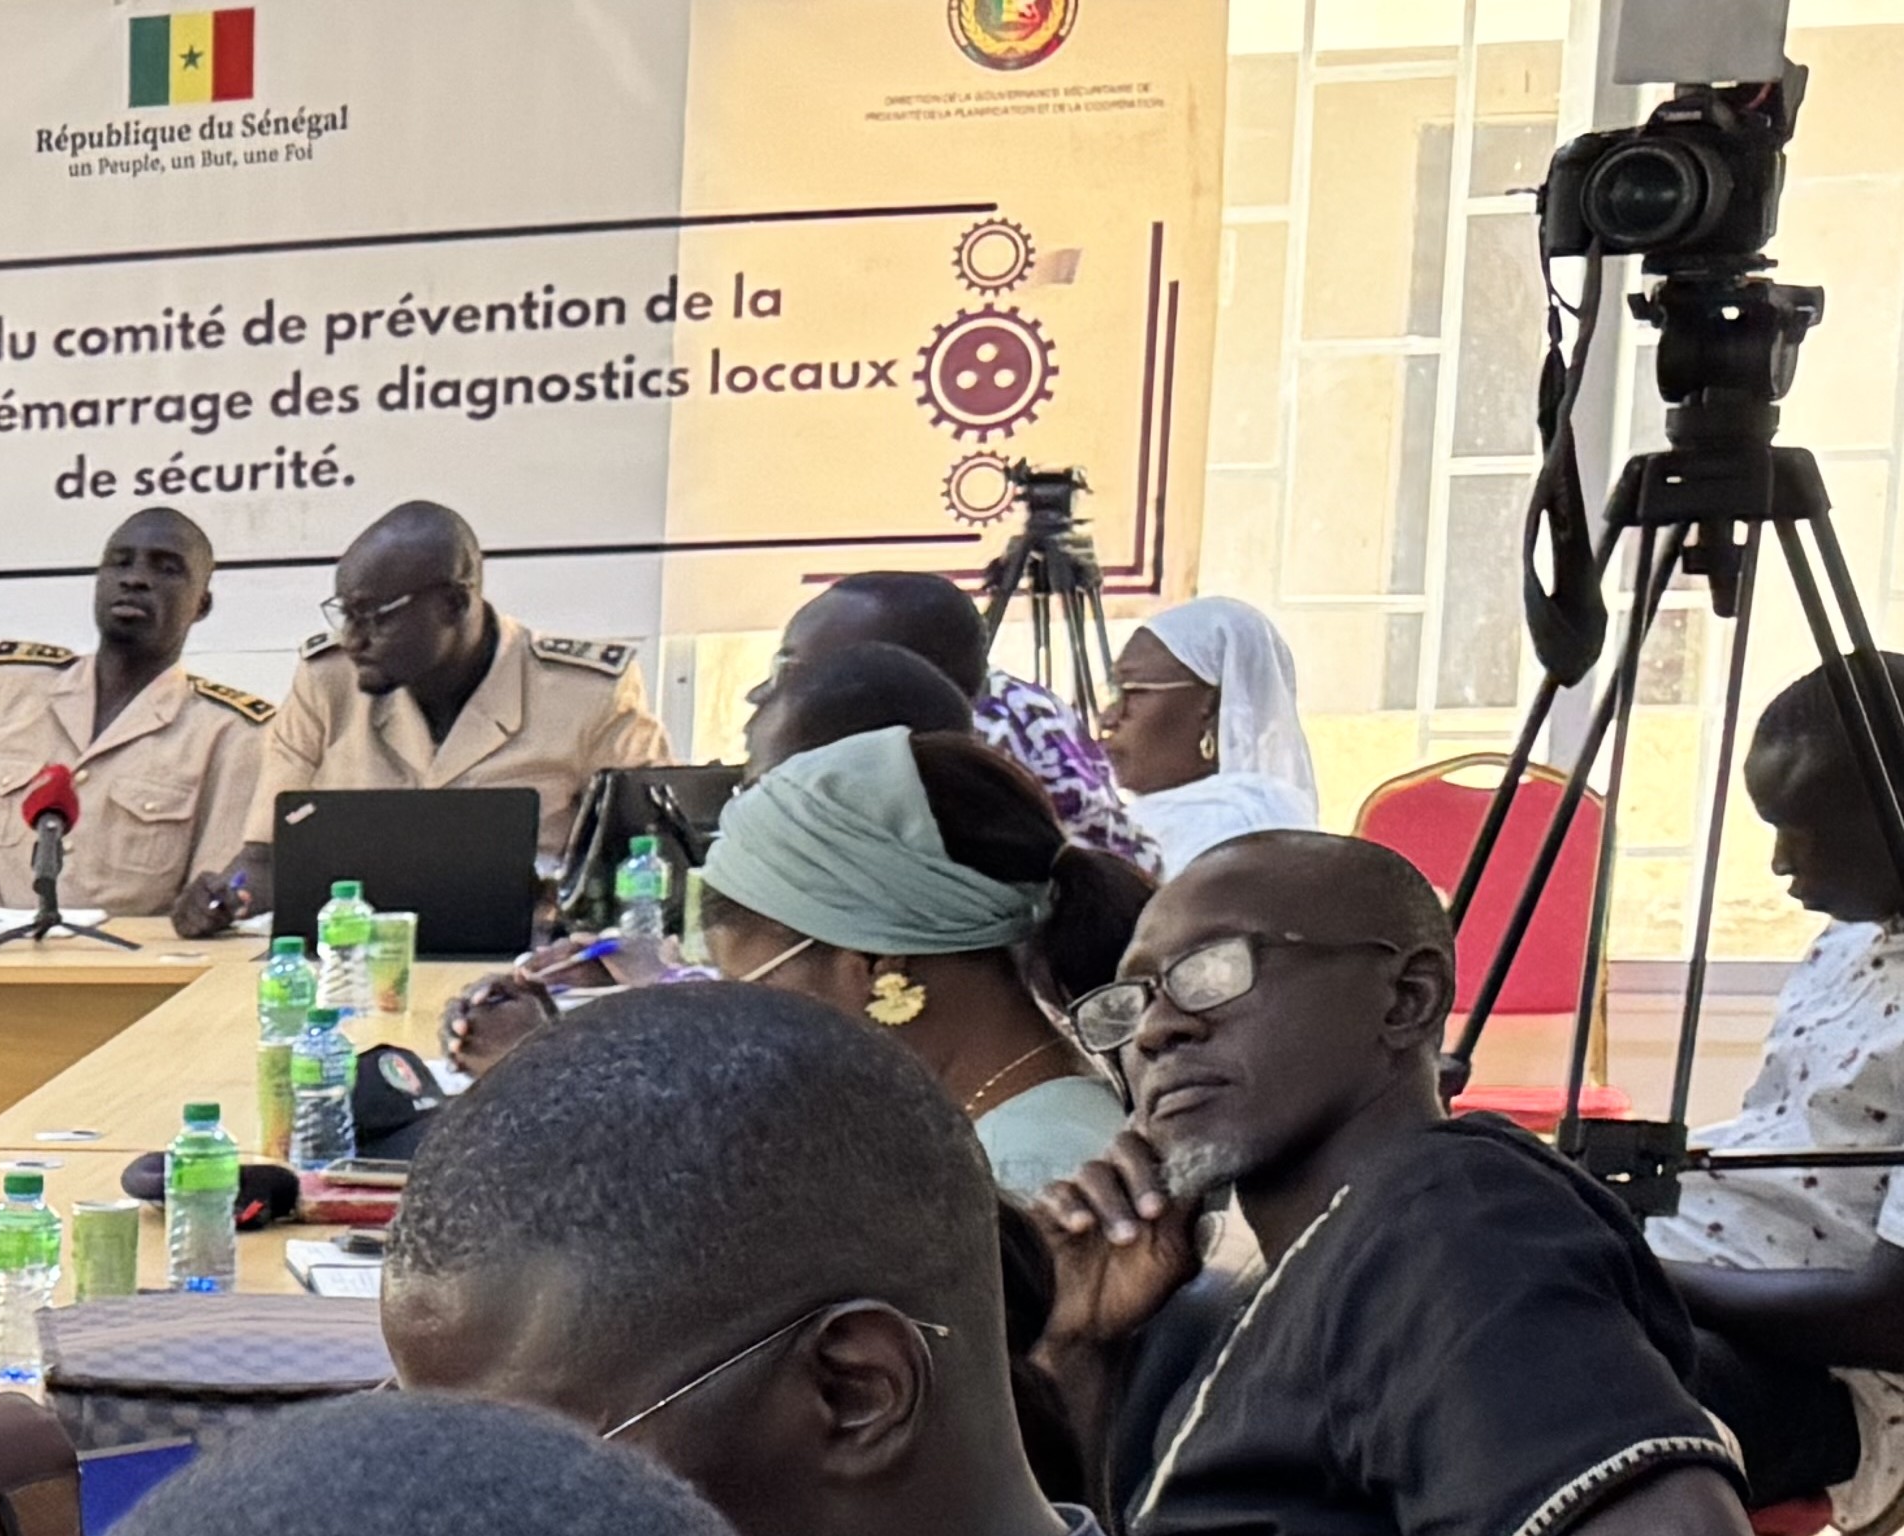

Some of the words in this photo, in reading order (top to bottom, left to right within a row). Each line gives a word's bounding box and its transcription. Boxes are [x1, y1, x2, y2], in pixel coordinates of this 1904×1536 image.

[36, 120, 192, 158] République
[199, 114, 234, 140] du
[242, 104, 349, 142] Sénégal
[69, 162, 93, 178] un
[99, 153, 166, 178] Peuple,
[171, 154, 196, 170] un
[244, 148, 279, 165] une
[285, 142, 313, 162] Foi
[53, 304, 226, 358] comité
[243, 298, 308, 347] de
[326, 284, 626, 356] prévention
[645, 274, 714, 324] de
[734, 272, 782, 319] la
[270, 370, 360, 418] des
[376, 354, 690, 412] diagnostics
[709, 348, 899, 395] locaux
[55, 453, 117, 500] de
[134, 443, 356, 497] sécurité.
